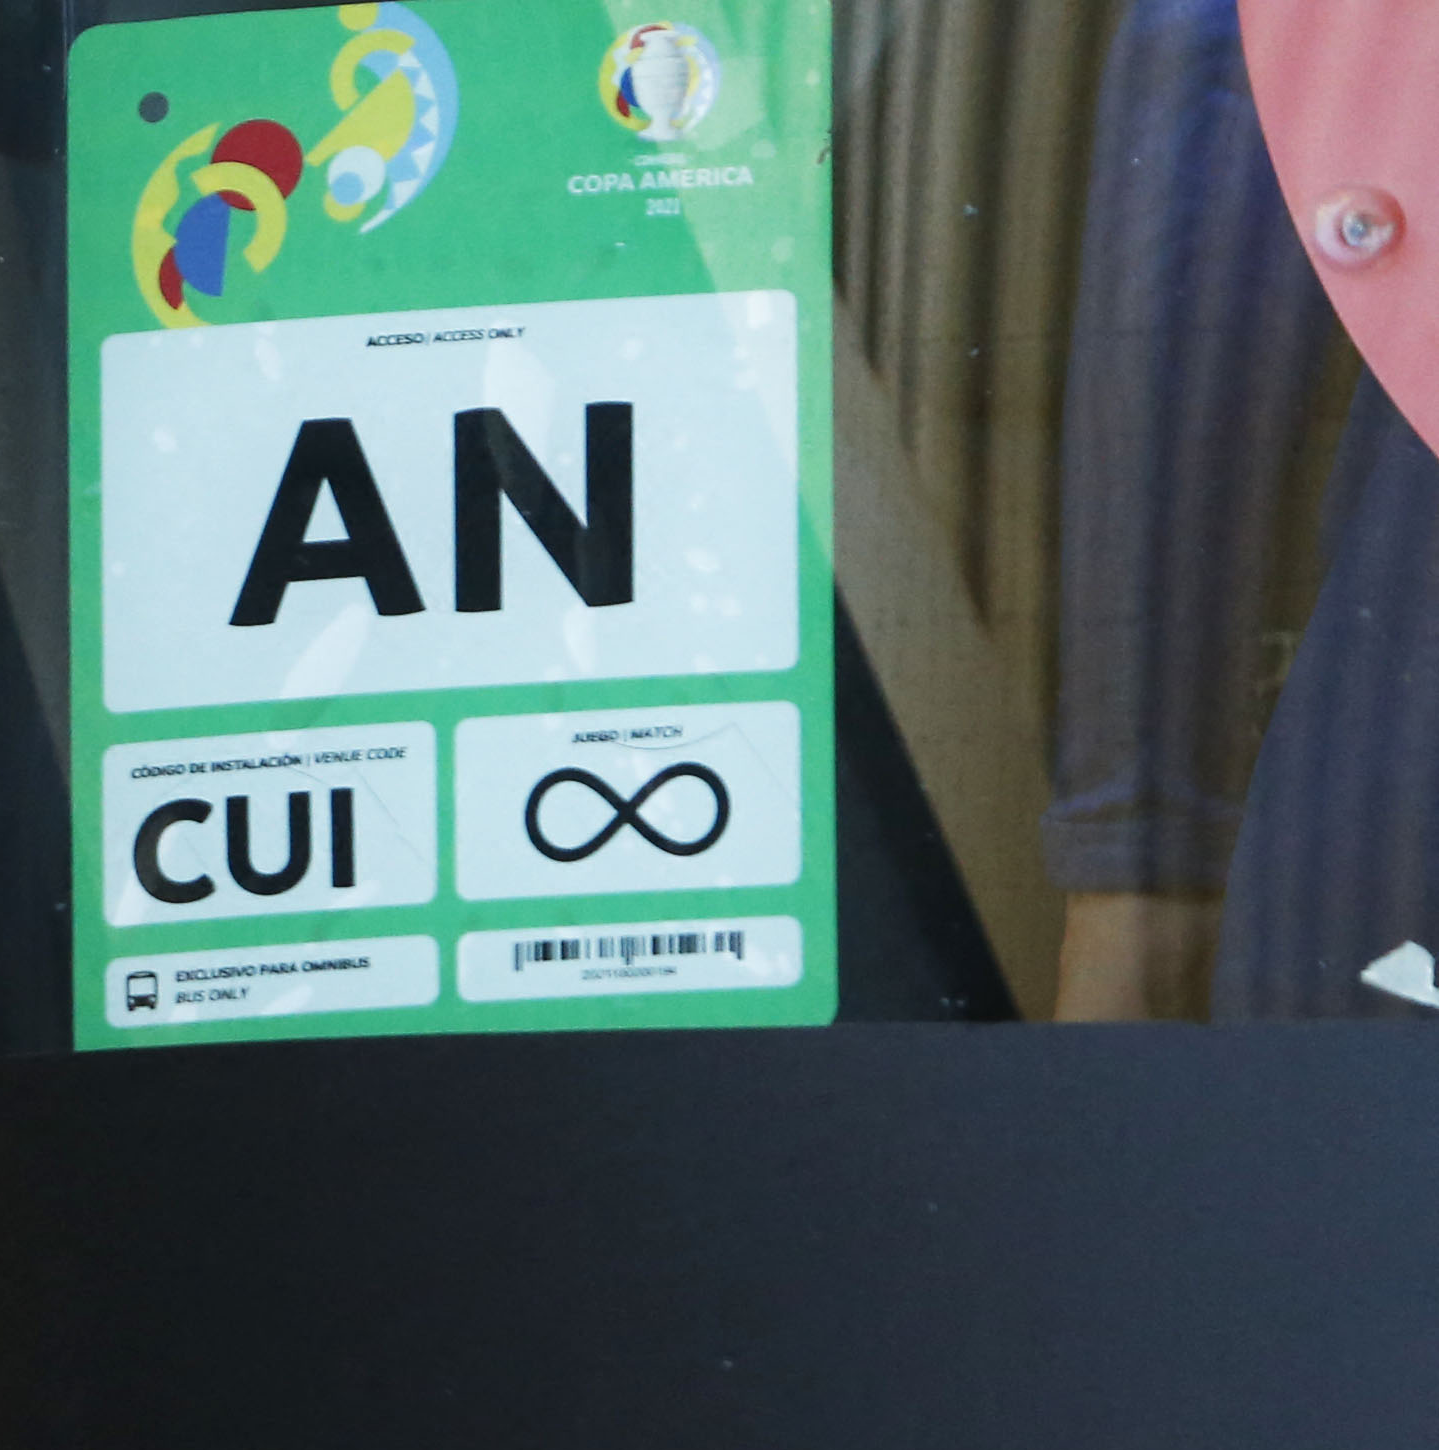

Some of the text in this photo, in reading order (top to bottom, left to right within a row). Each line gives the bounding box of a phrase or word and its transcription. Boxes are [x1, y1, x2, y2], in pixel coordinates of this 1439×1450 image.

[567, 173, 635, 194] COPA
[366, 326, 526, 346] ACCESO ACCESS ONLY
[229, 401, 634, 626] AN
[572, 725, 683, 743] JUEGO MATCH
[131, 747, 408, 779] CÓDIGO DE INSTALACIÓN VENUE CODE
[133, 788, 355, 904] CUI
[176, 956, 371, 982] EXCLUSIVO PARA OMNIBUS
[176, 986, 249, 1004] BUS ONLY
